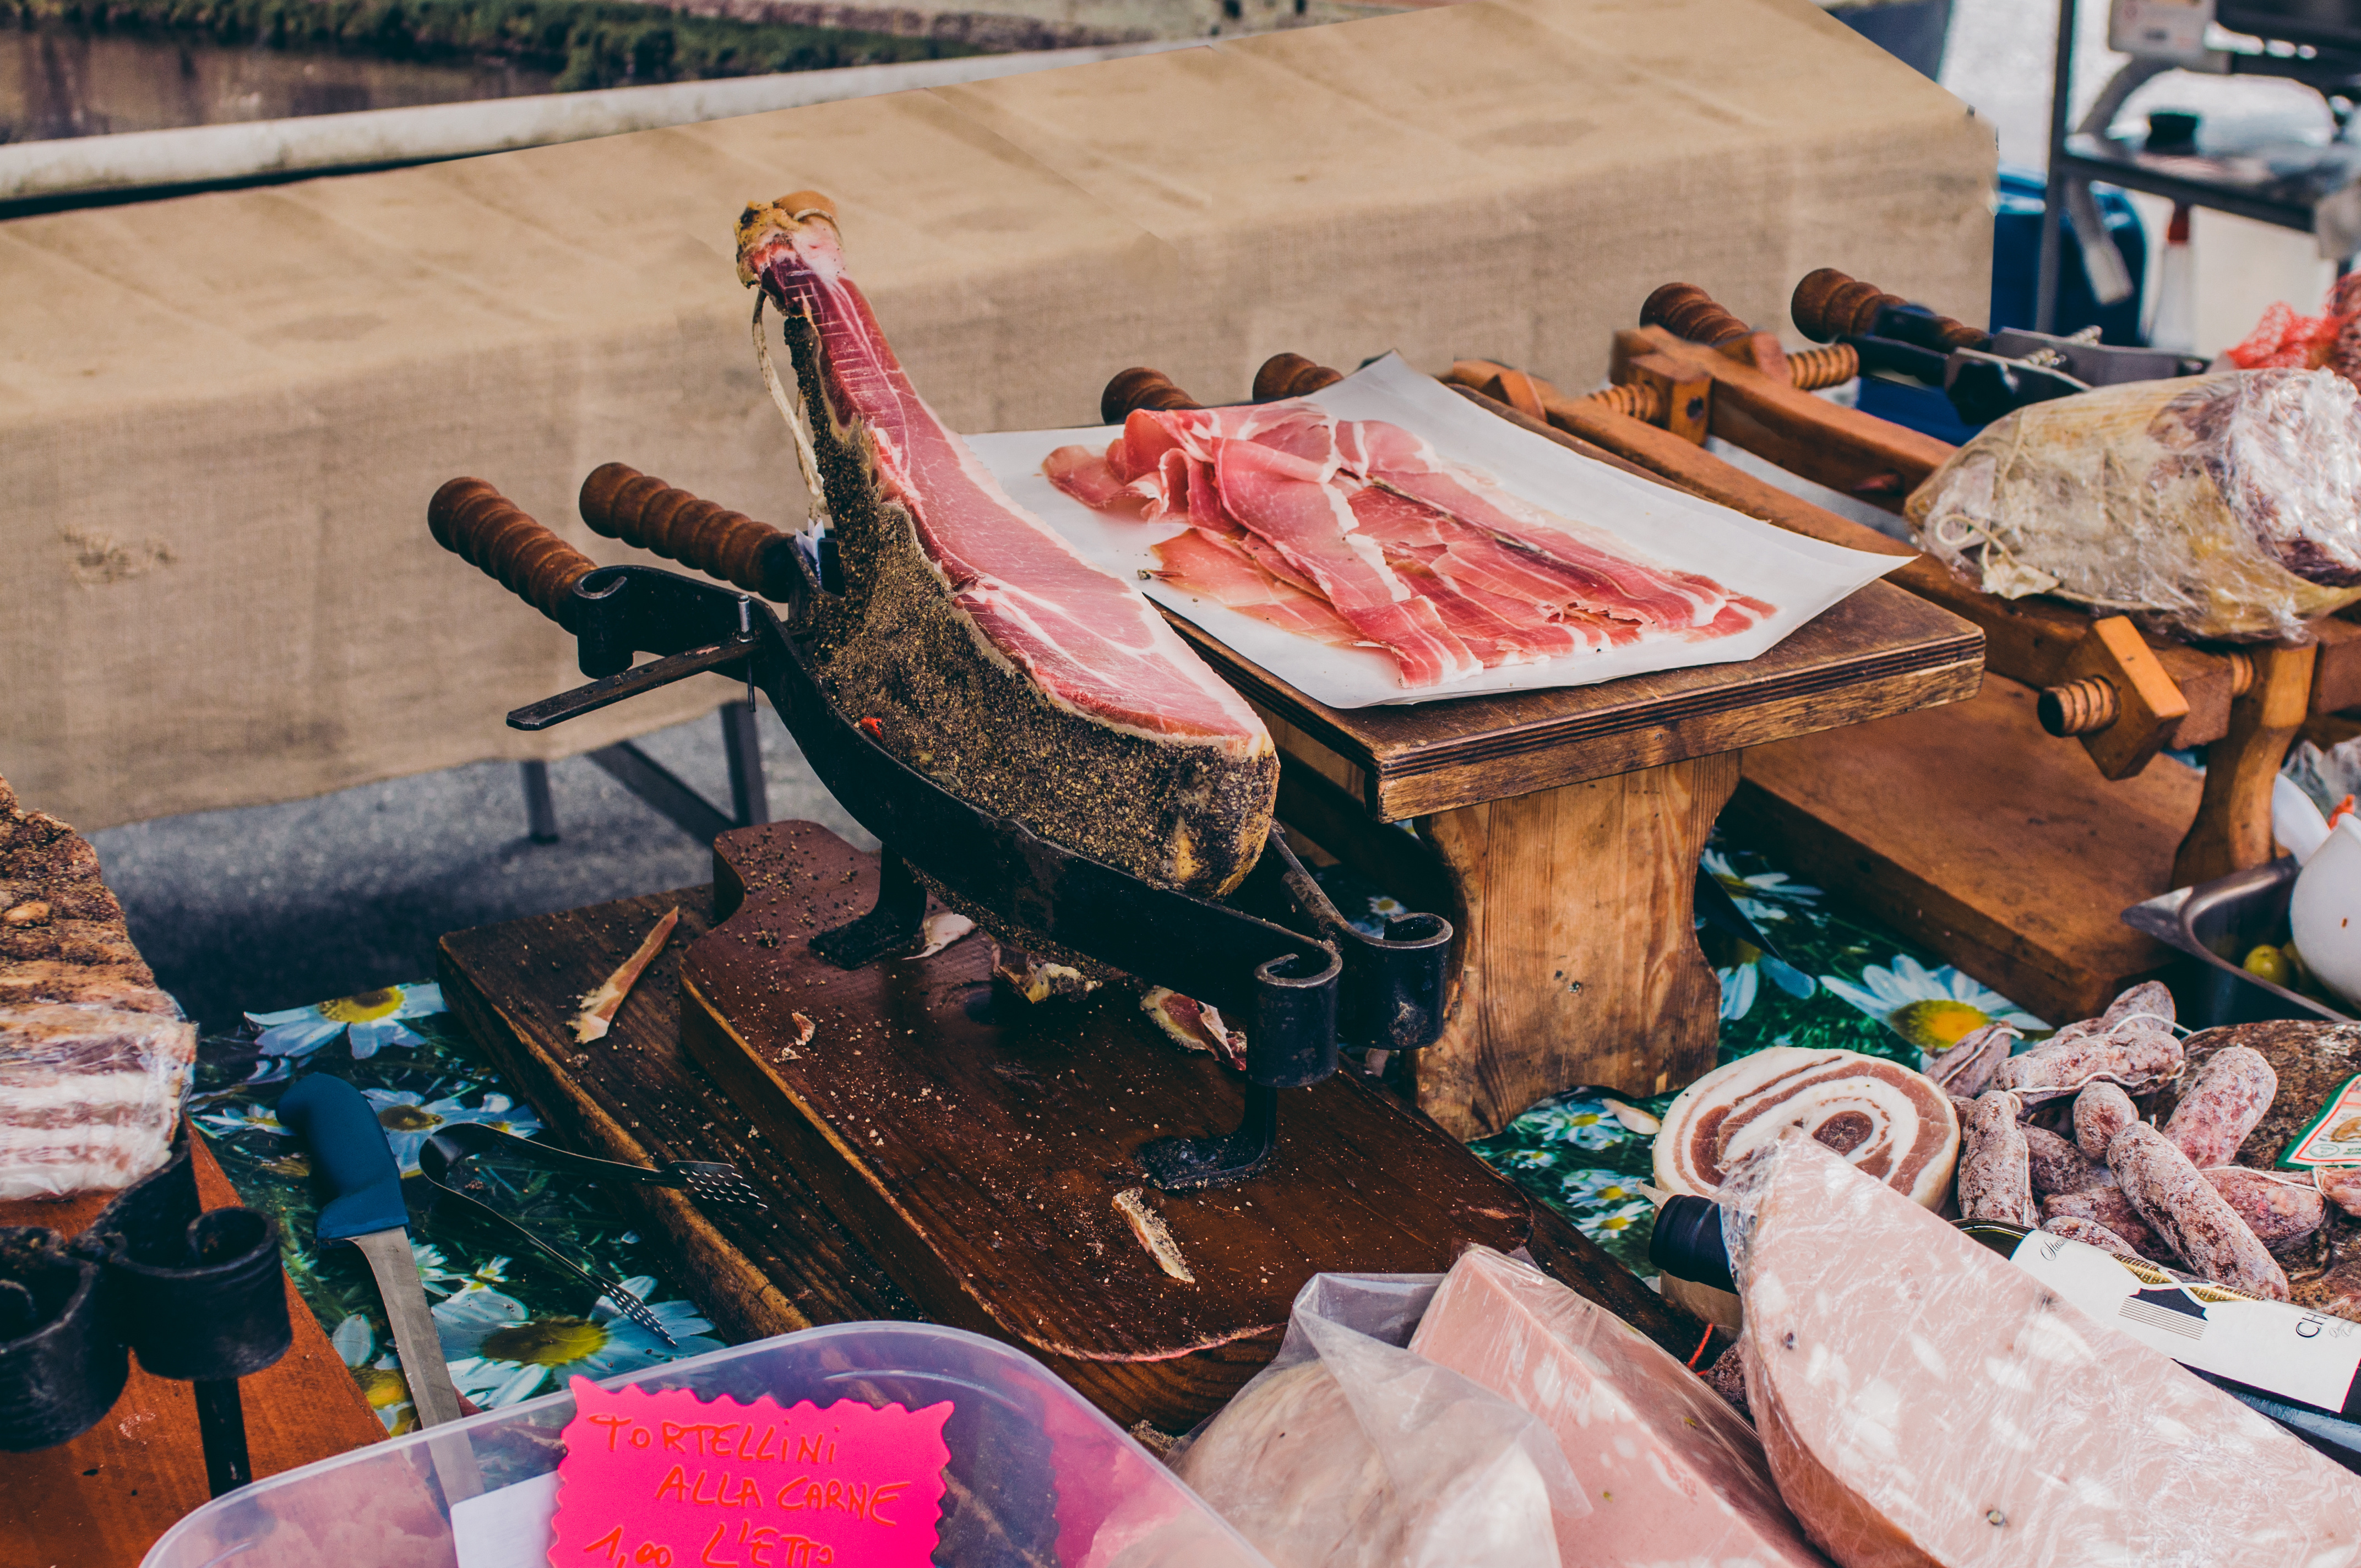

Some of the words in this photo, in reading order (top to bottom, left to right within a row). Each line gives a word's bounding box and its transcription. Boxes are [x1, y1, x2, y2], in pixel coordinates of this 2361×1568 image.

[655, 1465, 762, 1507] ALLA
[777, 1477, 911, 1527] CARNE
[584, 1526, 672, 1568] 1,00
